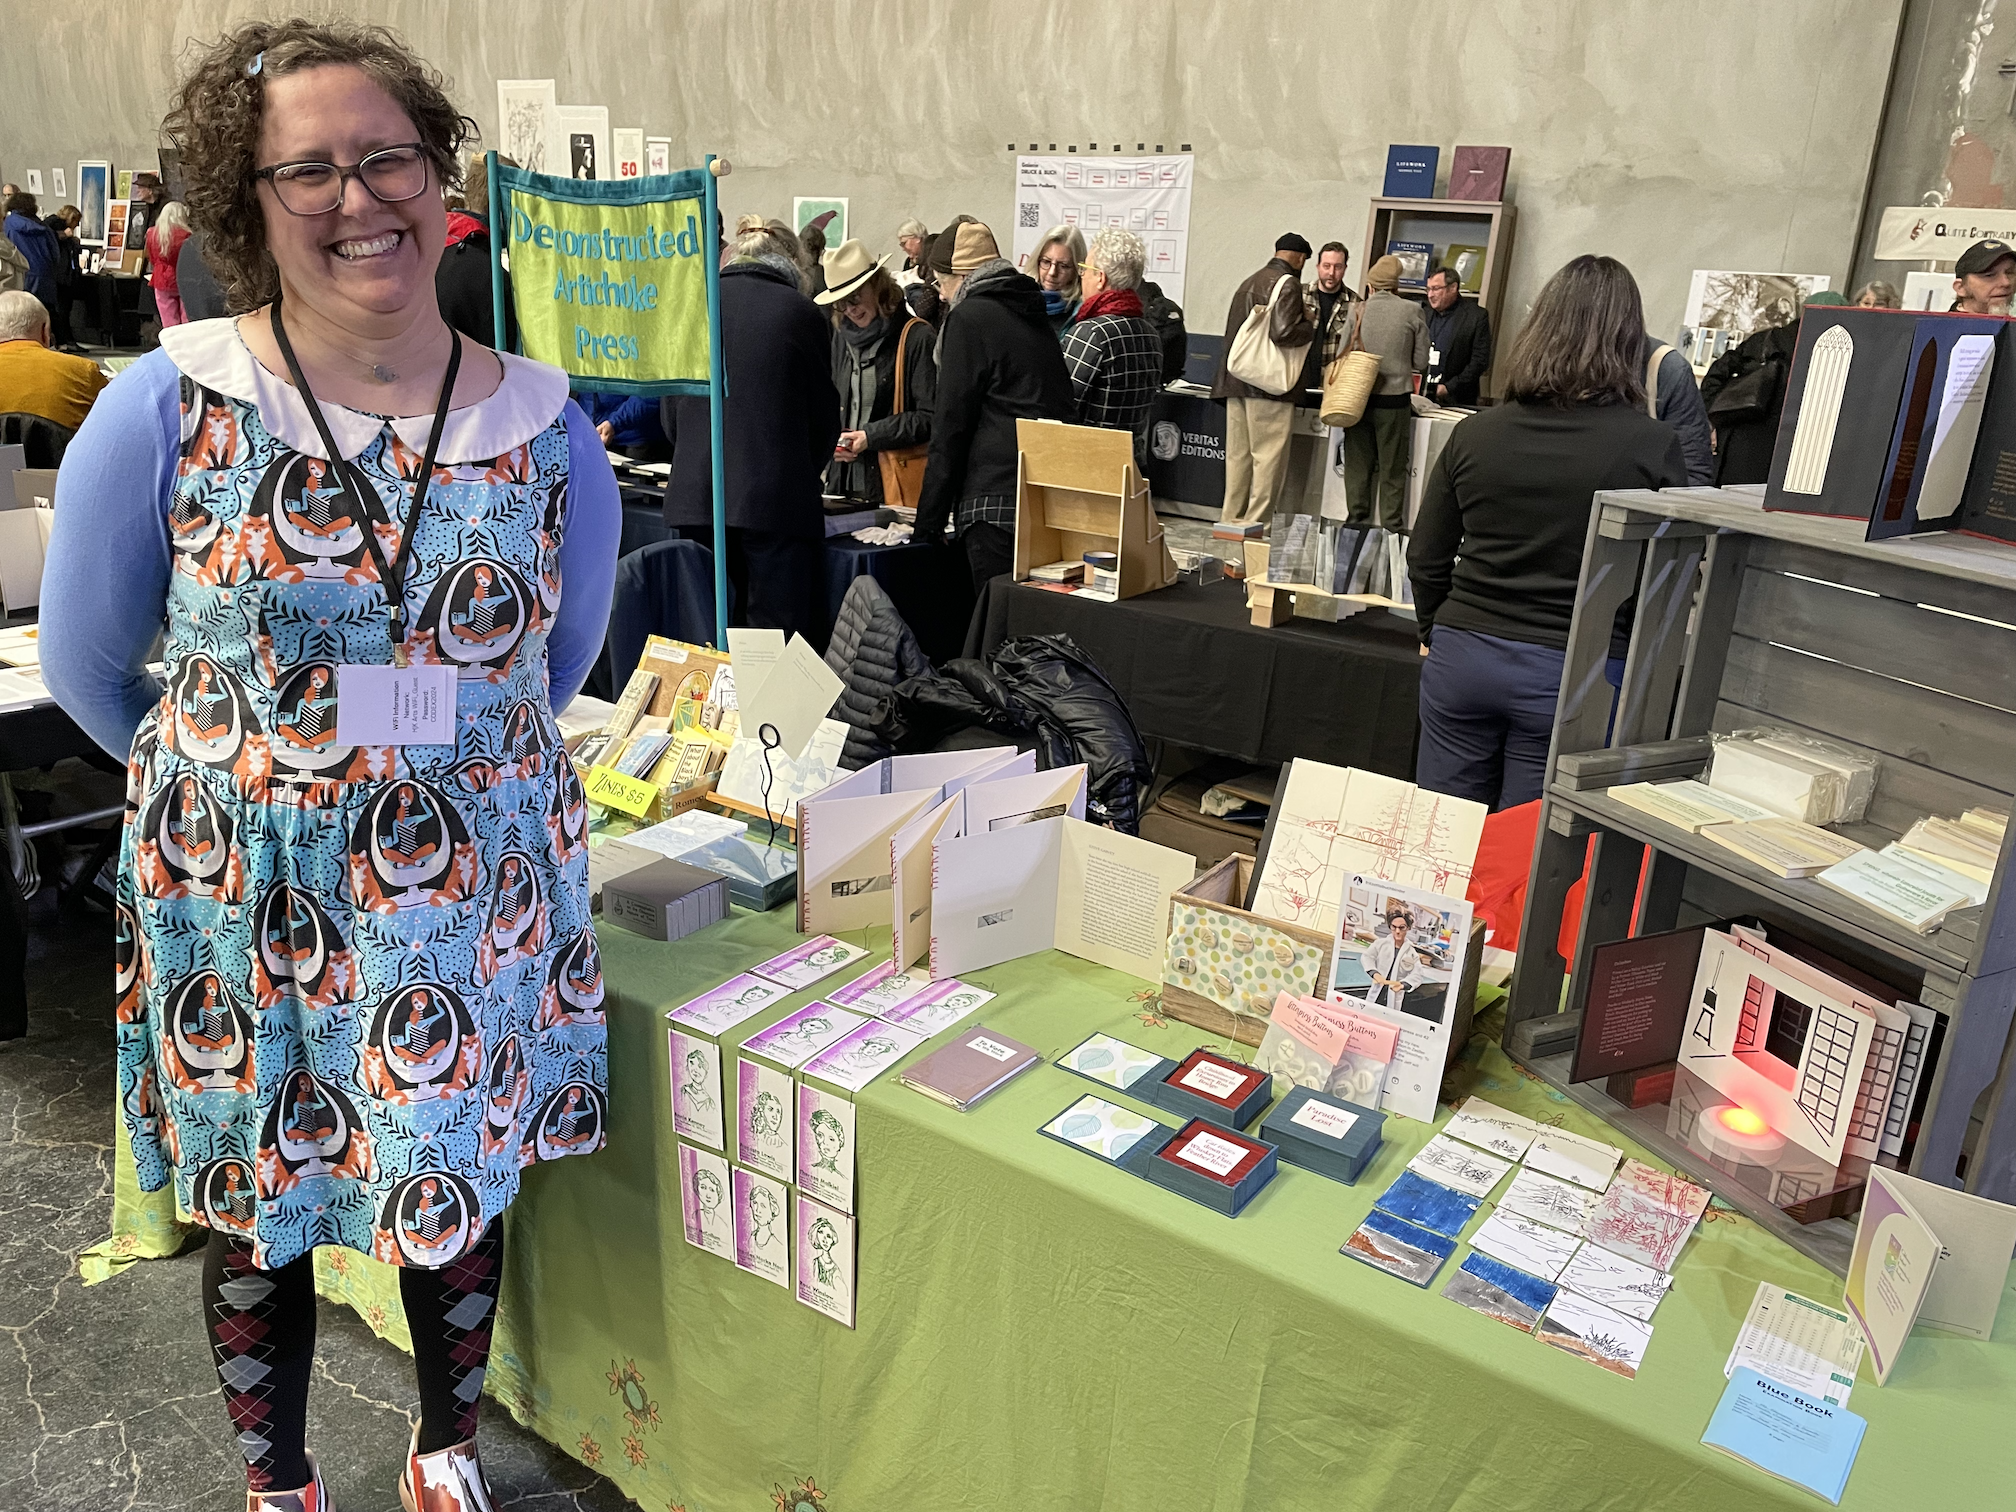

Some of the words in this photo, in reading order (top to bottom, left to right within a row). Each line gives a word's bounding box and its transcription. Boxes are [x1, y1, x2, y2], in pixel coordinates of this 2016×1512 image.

[621, 162, 637, 177] 50
[513, 206, 700, 262] Deconstructed
[554, 267, 657, 312] Artichoke
[575, 324, 639, 361] Press
[1182, 432, 1219, 446] VERITAS
[1182, 444, 1226, 460] EDITIONS
[592, 773, 627, 798] ZINES
[626, 789, 645, 804] $5
[675, 795, 704, 809] Romeo
[1312, 1015, 1334, 1038] Buttons
[1347, 1021, 1377, 1039] Buttons
[1307, 1106, 1346, 1124] Paradise
[1311, 1115, 1333, 1127] Lost
[1186, 1148, 1210, 1161] Feather
[1210, 1159, 1227, 1169] River
[1190, 1143, 1216, 1158] Whiskey
[1204, 1144, 1220, 1155] down
[812, 1287, 833, 1300] Winslow
[1757, 1380, 1789, 1399] Blue
[1794, 1397, 1834, 1418] Book
